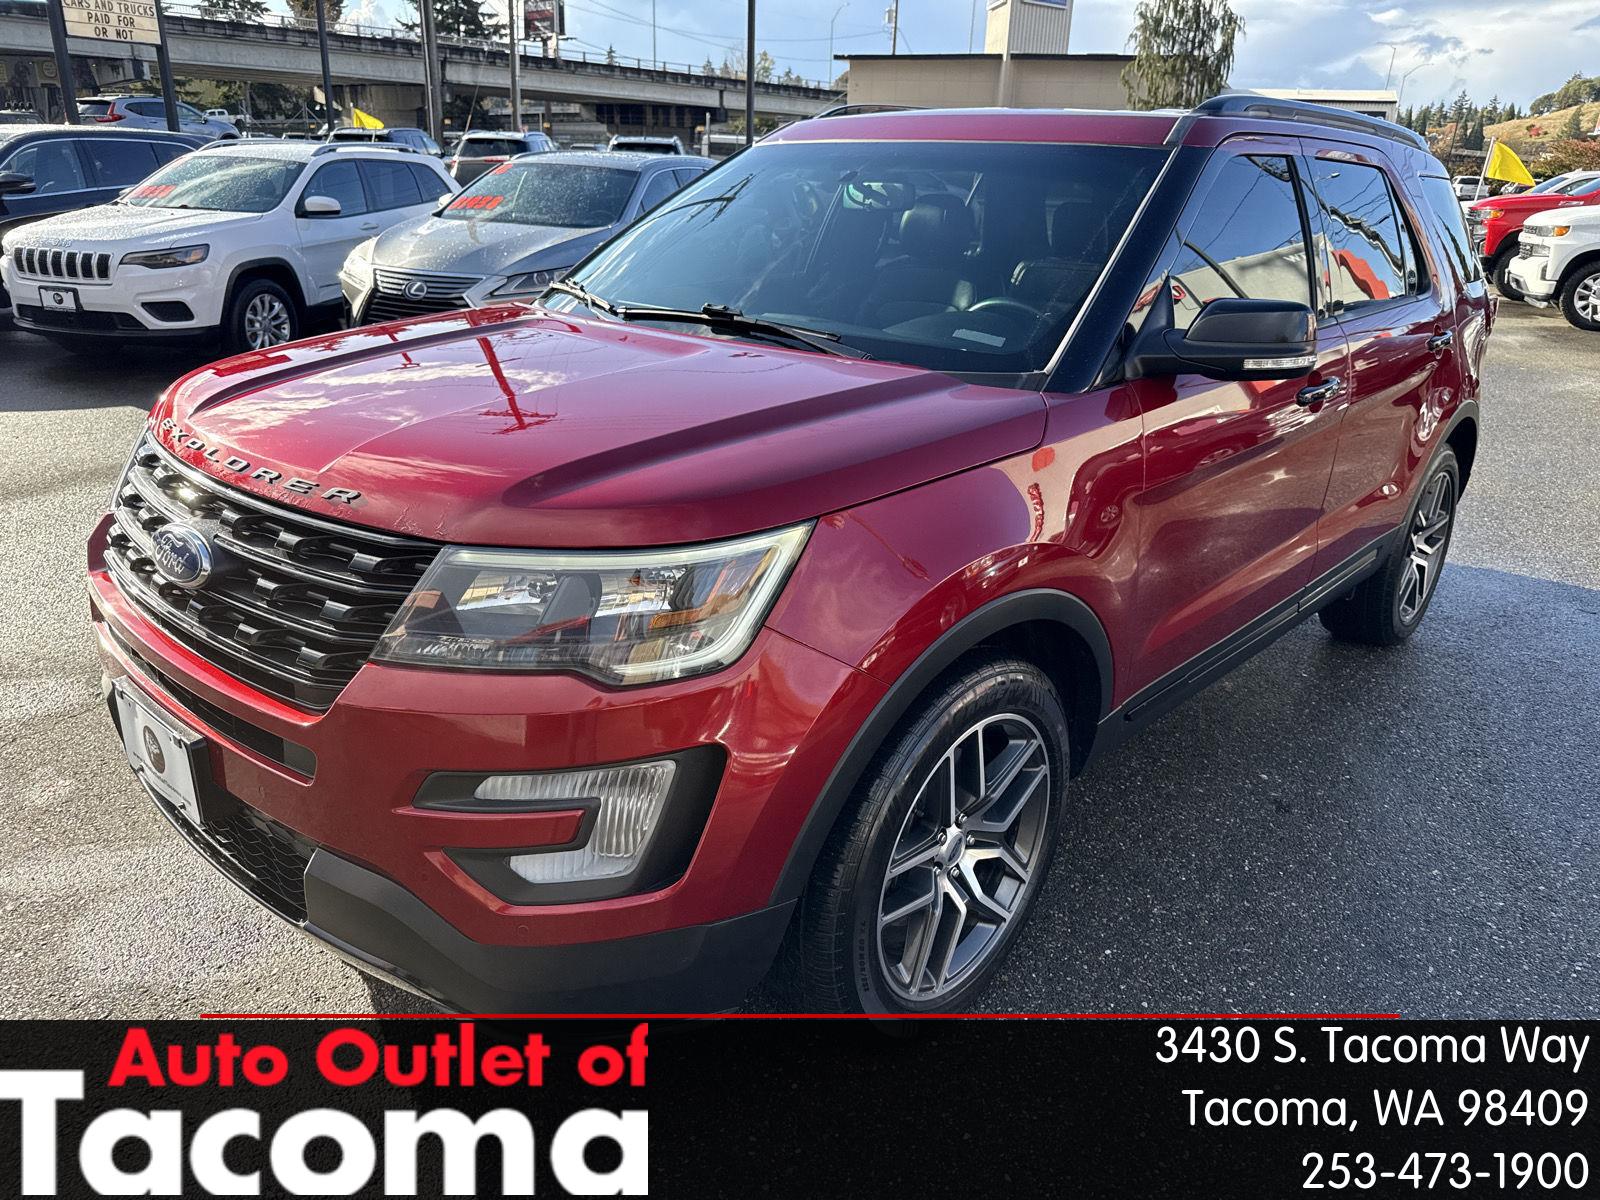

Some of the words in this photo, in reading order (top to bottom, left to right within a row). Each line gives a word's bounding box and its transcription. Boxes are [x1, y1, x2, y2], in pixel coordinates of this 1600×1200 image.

[63, 0, 91, 8] CARS
[94, 1, 114, 12] AND
[117, 2, 155, 17] TRUCKS
[87, 12, 110, 24] PAID
[117, 15, 136, 28] FOR
[94, 26, 109, 38] OR
[115, 28, 134, 41] NOT
[160, 418, 363, 505] EXPLORER
[155, 533, 190, 574] Ford
